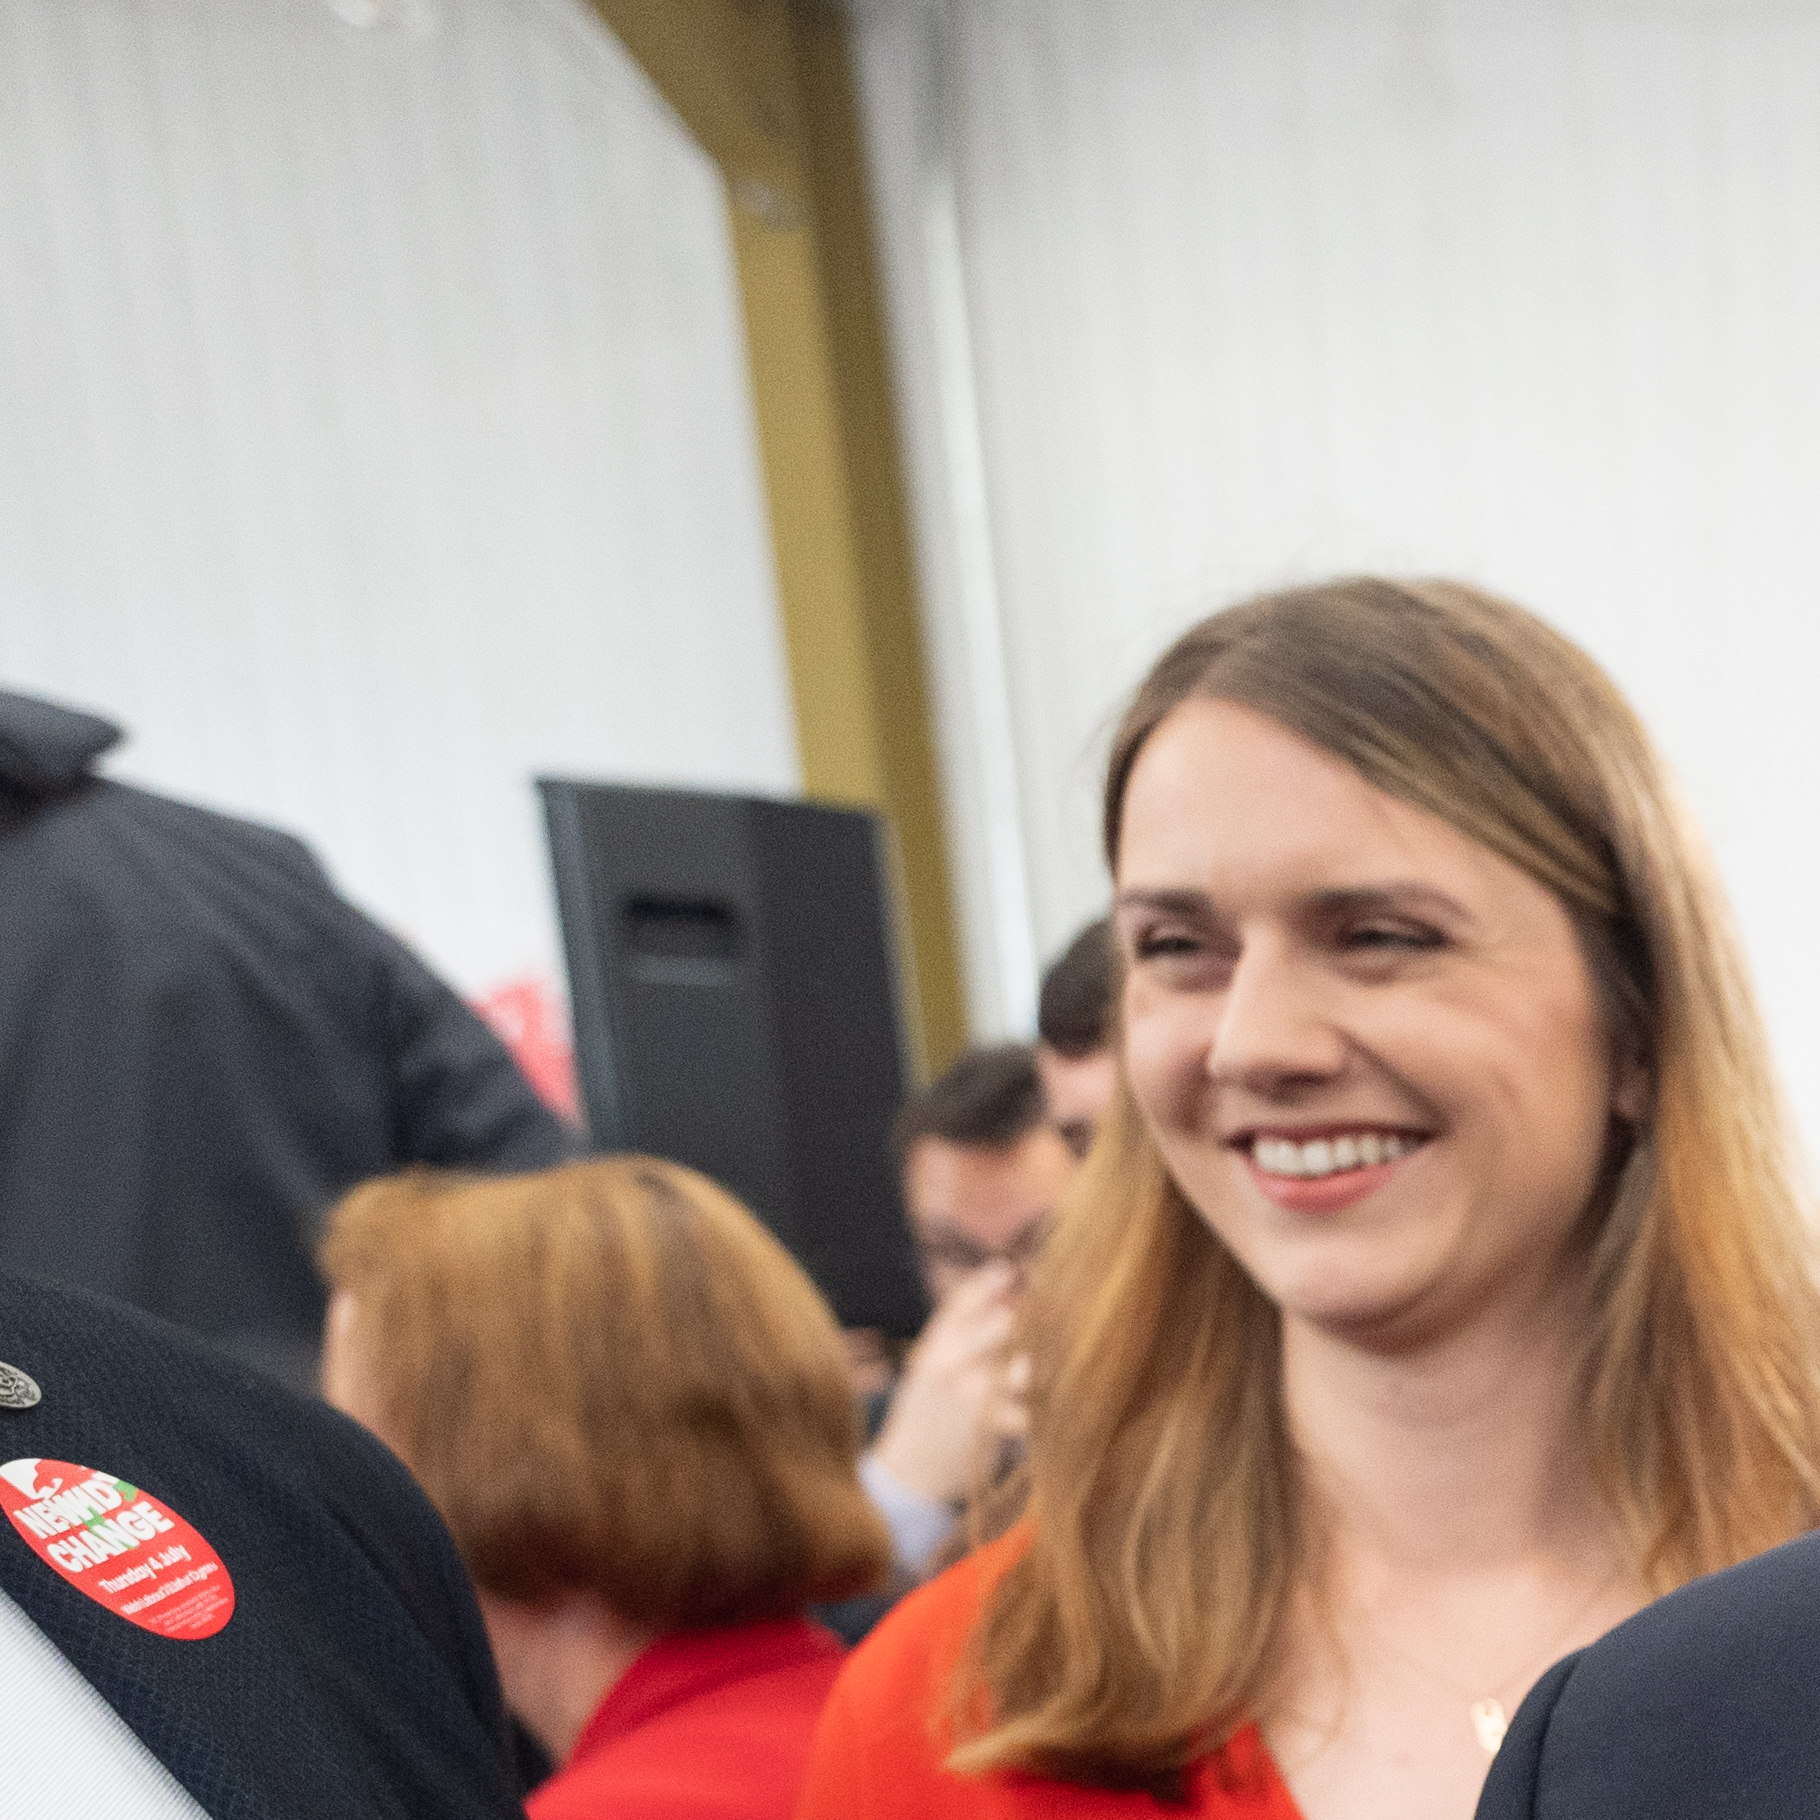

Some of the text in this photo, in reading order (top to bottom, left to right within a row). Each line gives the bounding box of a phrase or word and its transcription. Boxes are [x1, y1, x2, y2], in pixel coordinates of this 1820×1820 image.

[47, 1501, 174, 1573] CHANGE
[98, 1545, 192, 1594] Thursday 4 July
